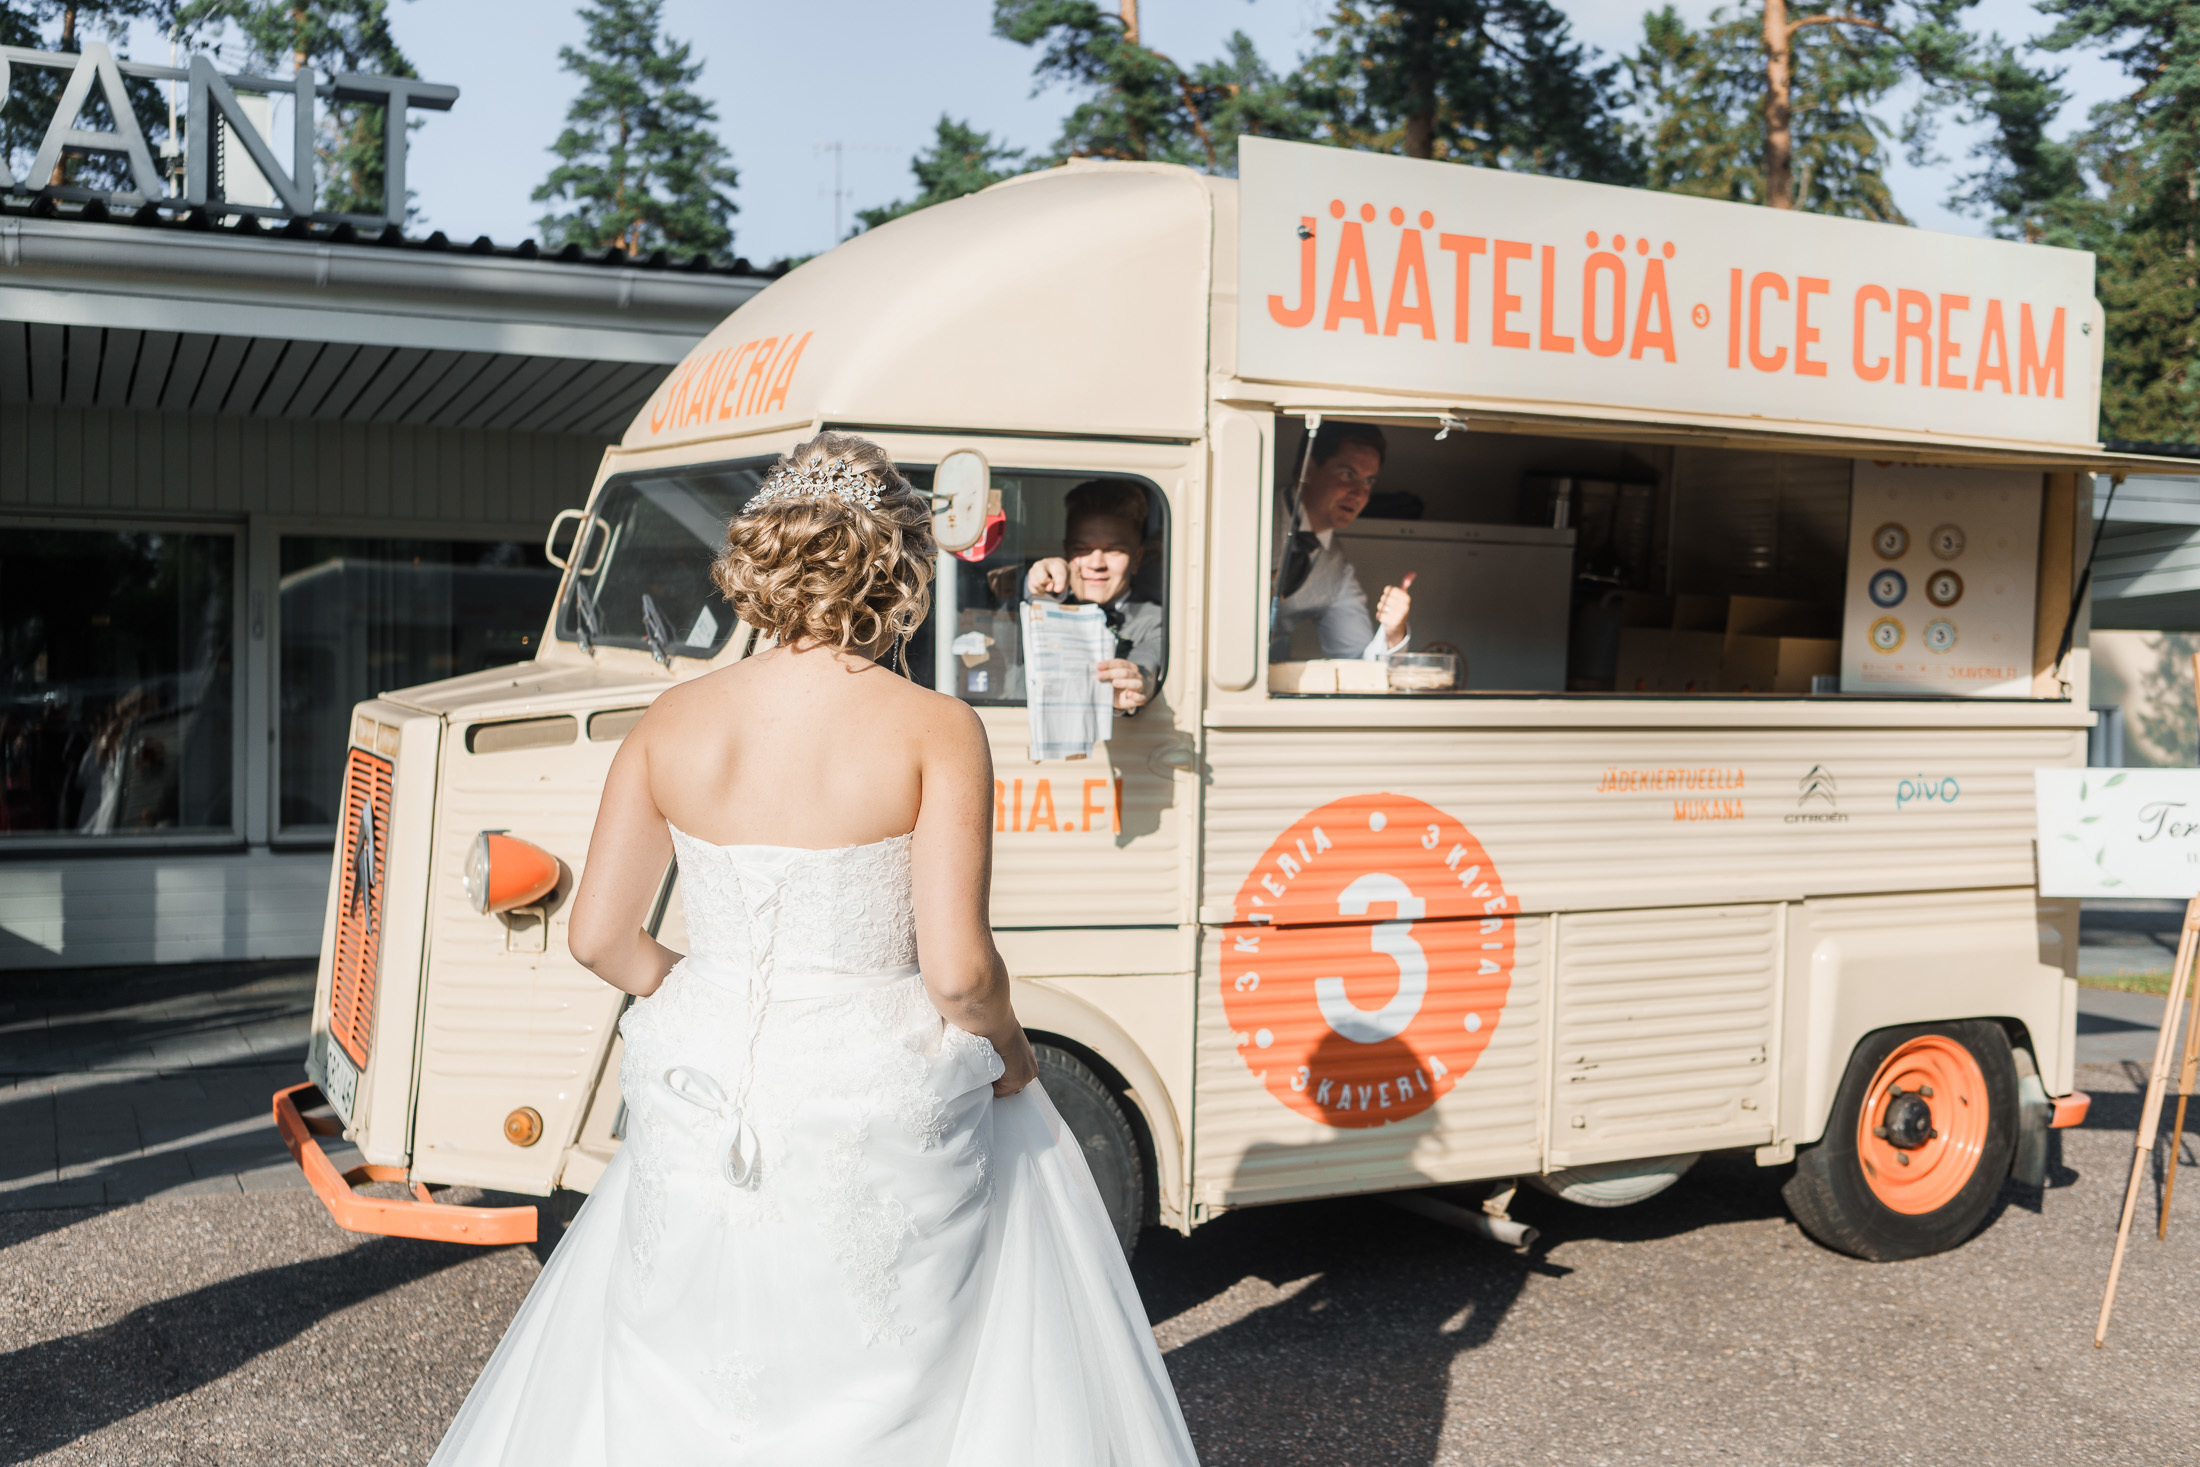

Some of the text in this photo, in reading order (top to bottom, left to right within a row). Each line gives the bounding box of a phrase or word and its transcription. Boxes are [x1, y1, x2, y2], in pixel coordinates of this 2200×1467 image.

[0, 41, 460, 226] ANT
[1267, 199, 1677, 364] JÄÄTELÖÄ
[1728, 268, 1830, 377] ICE
[1852, 284, 2065, 399] CREAM
[1673, 799, 1745, 822] MUKANA
[1897, 773, 1960, 810] pivo
[1315, 872, 1428, 1044] 3
